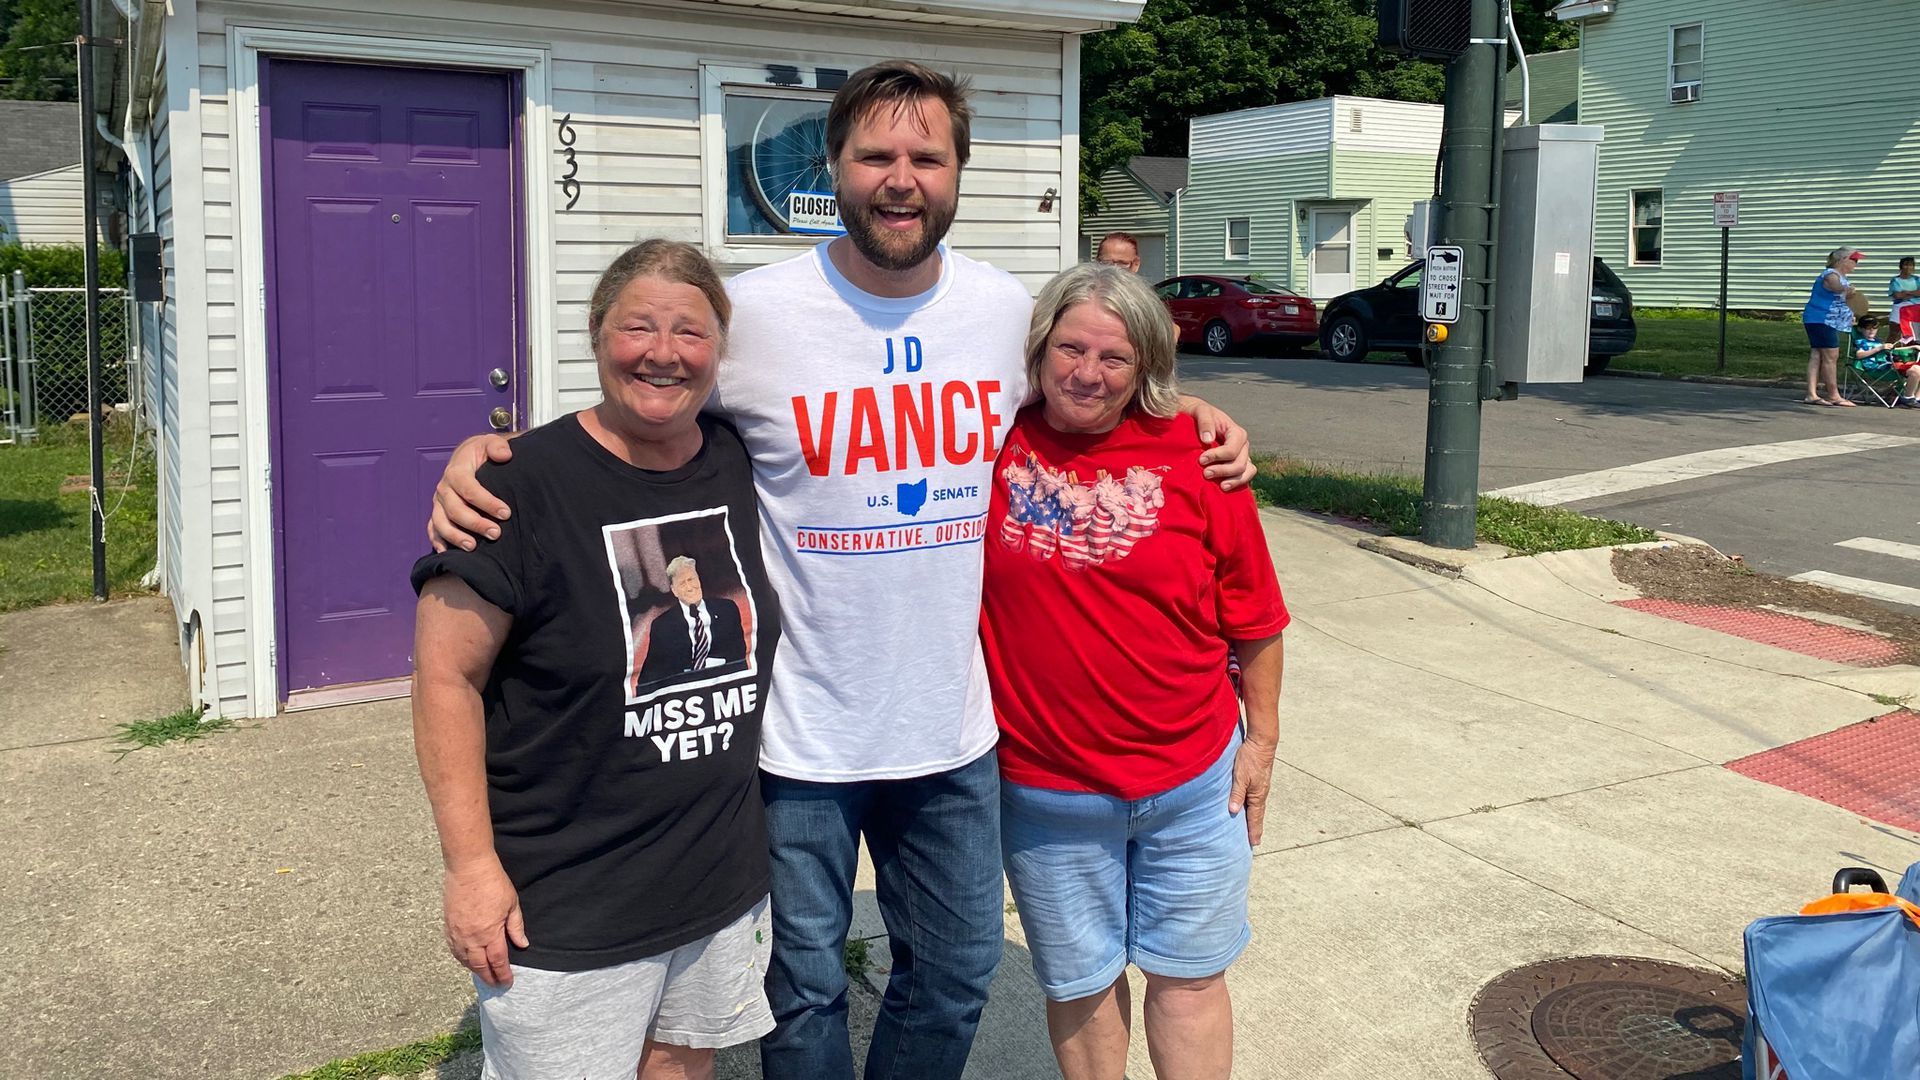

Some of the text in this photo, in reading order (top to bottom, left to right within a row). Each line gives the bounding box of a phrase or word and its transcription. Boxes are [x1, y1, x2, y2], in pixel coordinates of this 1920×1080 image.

[558, 112, 581, 211] 639
[793, 196, 836, 216] CLOSED
[791, 380, 1002, 476] VANCE
[867, 486, 978, 507] U.S. SENATE
[797, 528, 928, 550] CONSERVATIVE.
[624, 683, 757, 737] MISS ME
[650, 721, 734, 763] YET?
